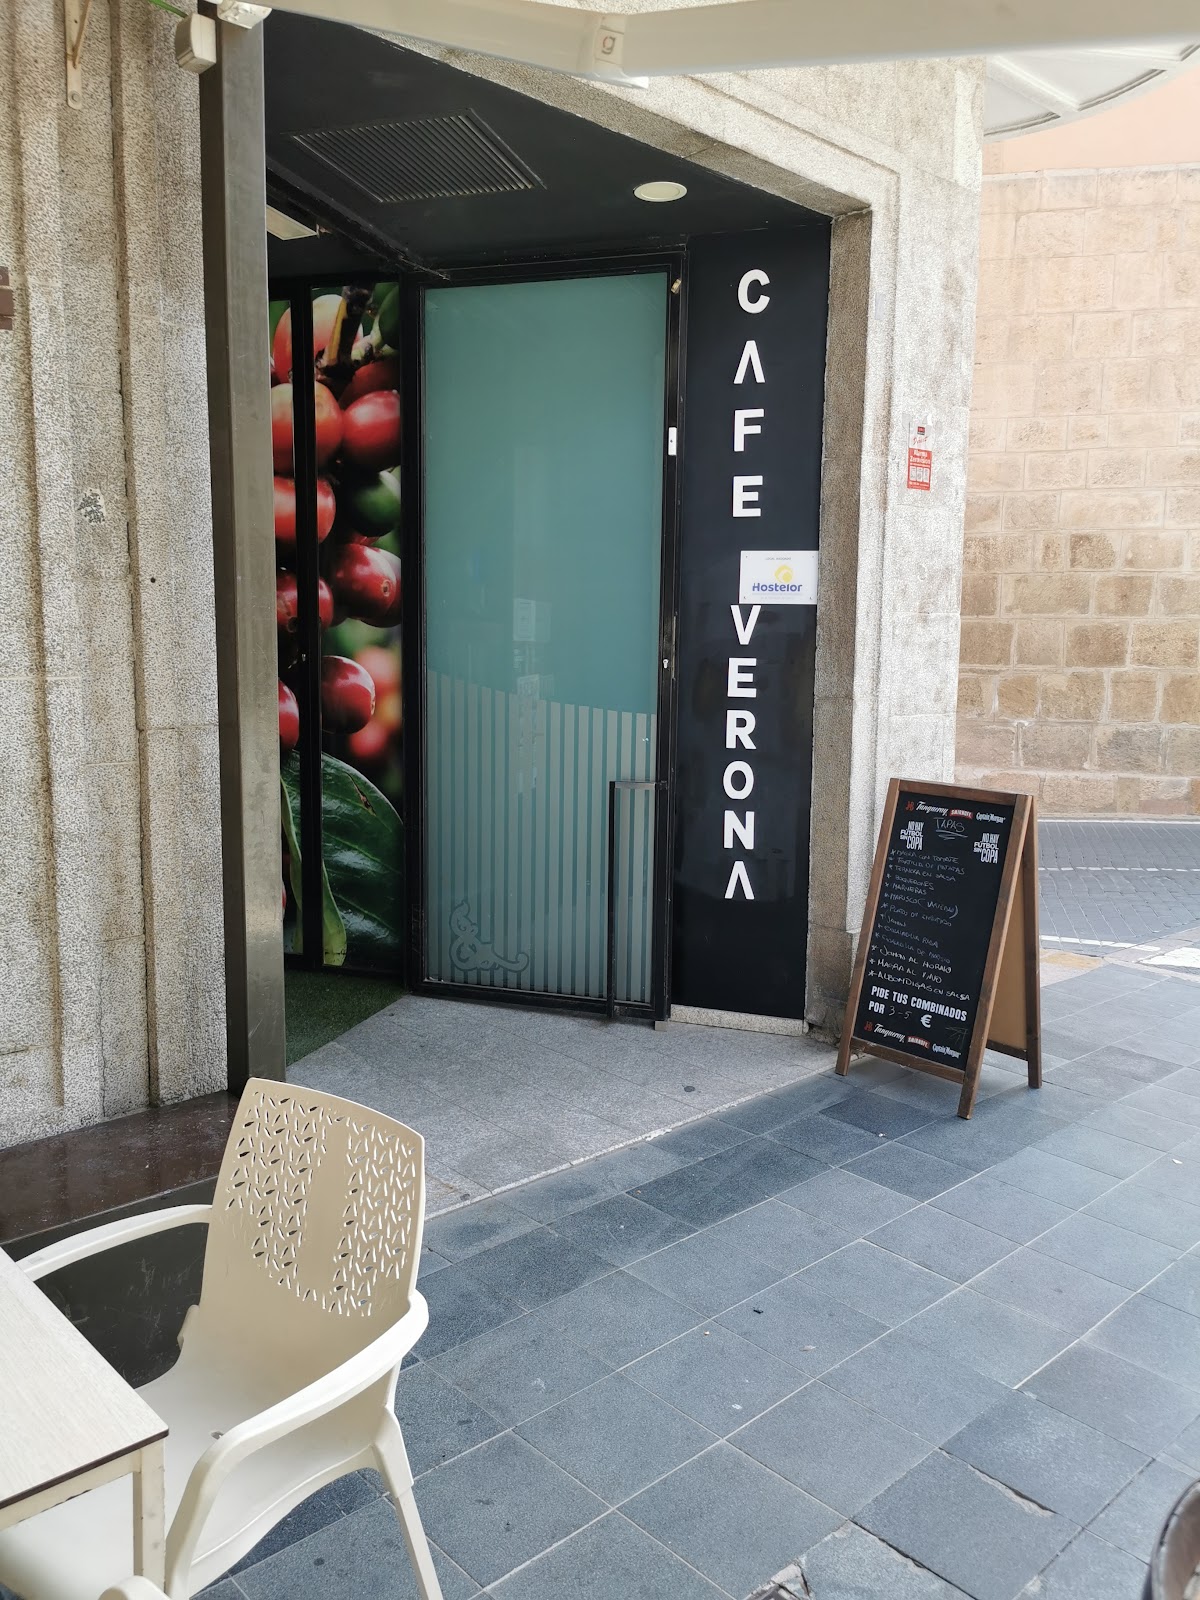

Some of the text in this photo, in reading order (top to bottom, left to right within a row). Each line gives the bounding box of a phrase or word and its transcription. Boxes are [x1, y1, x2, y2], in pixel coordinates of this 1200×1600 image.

[752, 582, 803, 592] Hostelor
[723, 604, 762, 900] VERONA
[916, 800, 948, 816] Tanqueray
[908, 821, 925, 832] NO HAY
[933, 817, 965, 832] TAPAS
[906, 836, 922, 850] COPA
[982, 833, 1000, 844] NO HAY
[980, 849, 998, 864] COPA
[922, 960, 952, 974] HORNO
[871, 986, 968, 1022] PIDE TUS COMBINADOS
[868, 1000, 886, 1015] POR
[920, 1014, 933, 1028] €
